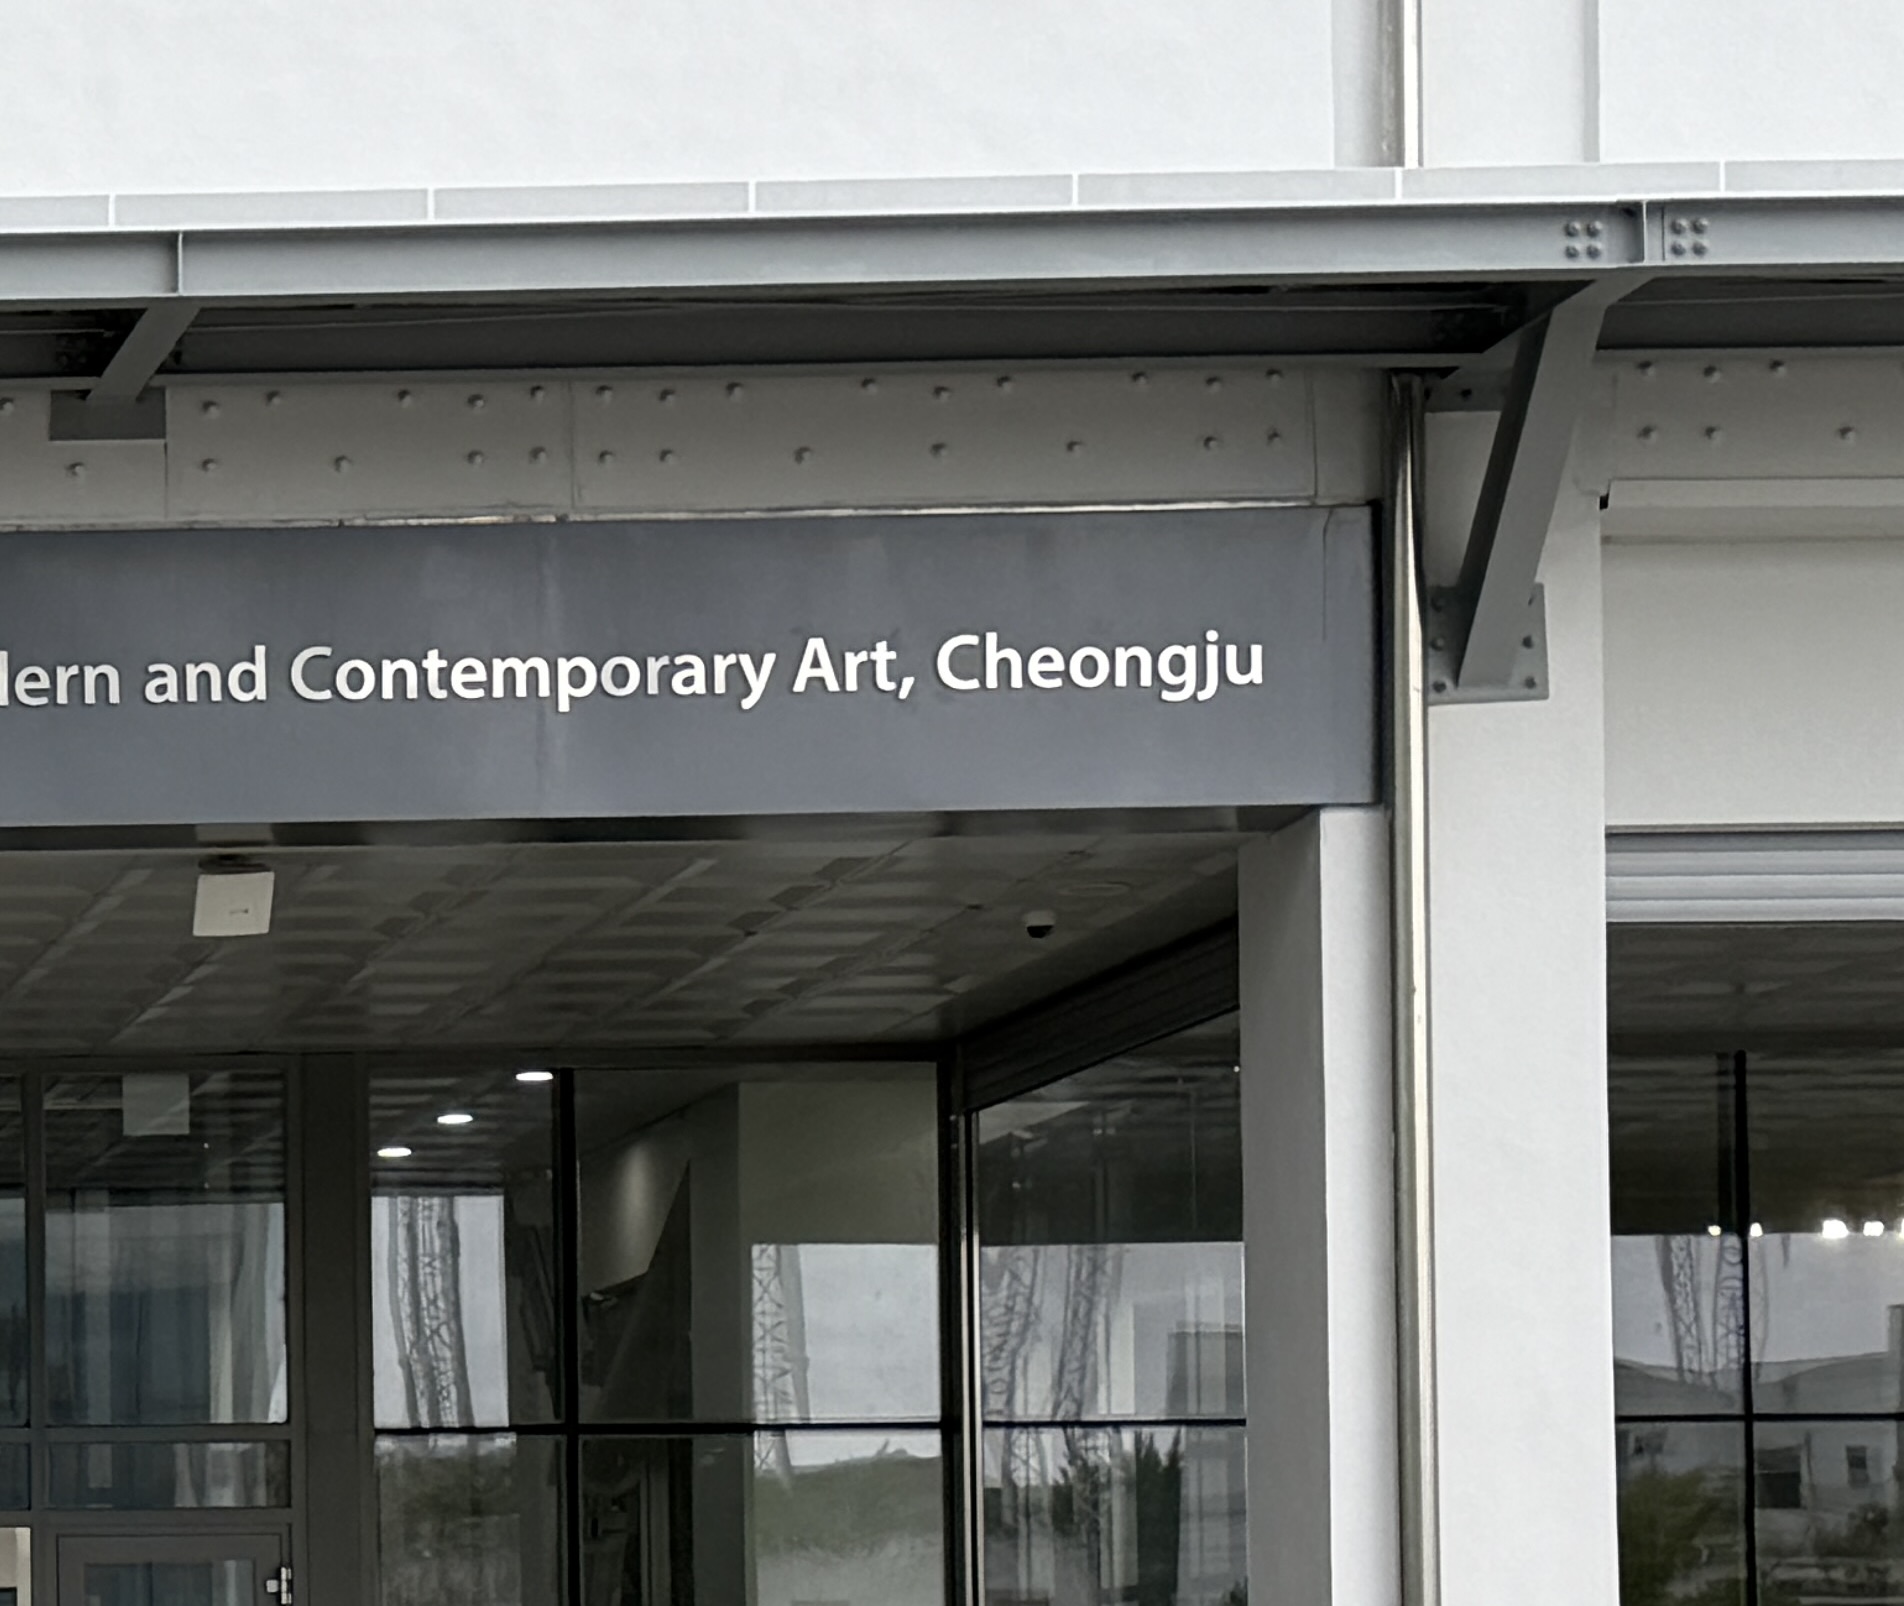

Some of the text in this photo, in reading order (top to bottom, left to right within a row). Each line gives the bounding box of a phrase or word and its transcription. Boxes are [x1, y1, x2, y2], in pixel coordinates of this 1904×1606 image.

[145, 644, 267, 703] and
[290, 644, 777, 712] Contemporary
[792, 637, 915, 699] Art,
[936, 629, 1264, 702] Cheongju
